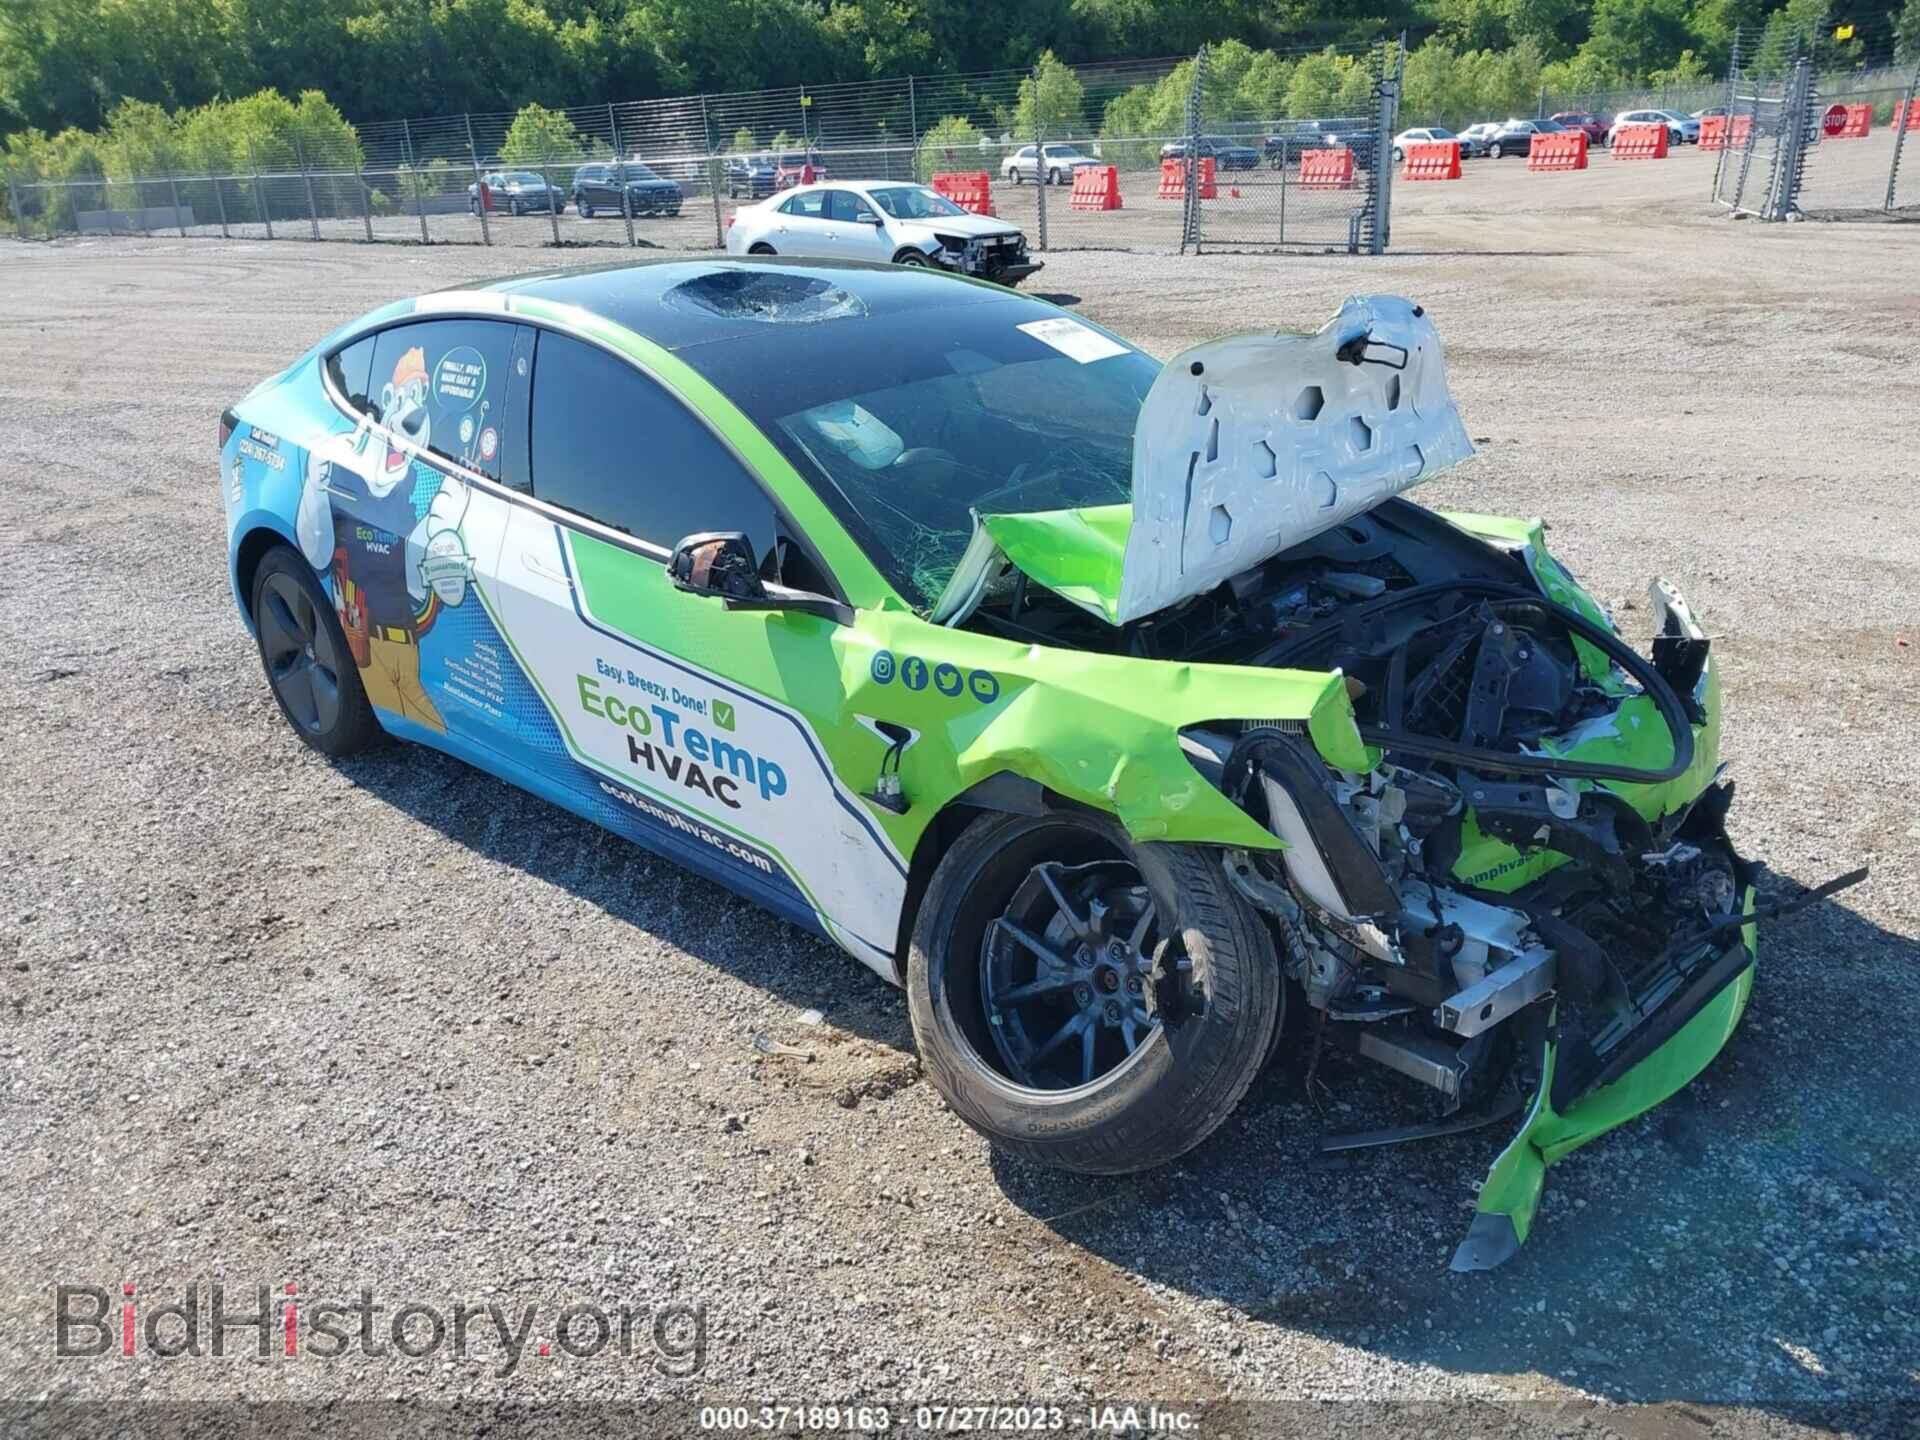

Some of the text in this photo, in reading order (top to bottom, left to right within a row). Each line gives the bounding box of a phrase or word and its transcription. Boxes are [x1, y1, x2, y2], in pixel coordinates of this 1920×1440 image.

[1824, 113, 1847, 128] STOP
[356, 527, 399, 544] EcoTemp
[366, 541, 390, 555] HVAC
[596, 658, 708, 716] Easy. Breezy. Done!
[576, 674, 788, 801] EcoTemp
[626, 734, 742, 809] HVAC
[600, 781, 773, 874] ecotemphvac.com
